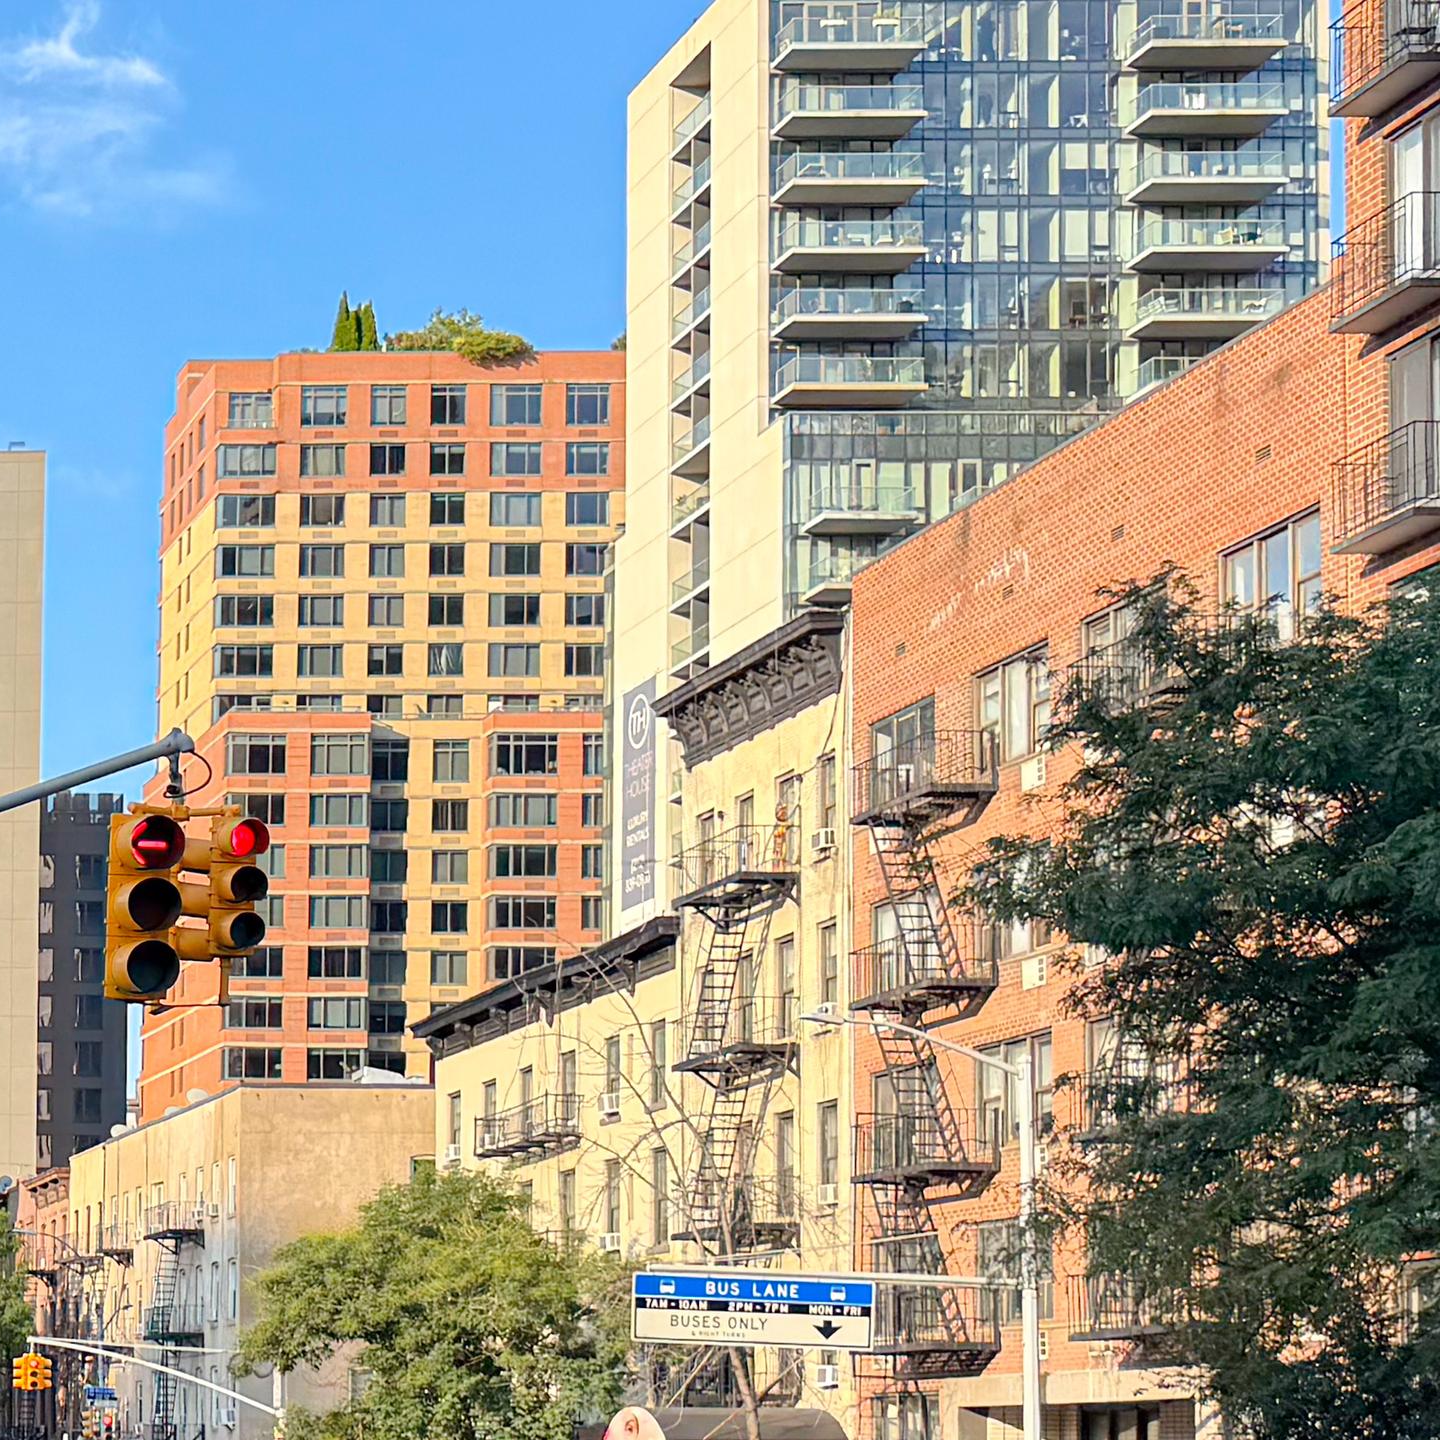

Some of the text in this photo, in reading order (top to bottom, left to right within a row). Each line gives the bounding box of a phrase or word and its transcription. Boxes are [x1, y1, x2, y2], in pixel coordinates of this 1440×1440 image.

[626, 775, 650, 799] HOUSE
[705, 1281, 800, 1299] BUS LANE
[645, 1297, 668, 1309] 7AM
[678, 1299, 708, 1311] 10AM
[727, 1301, 752, 1312] 2PM
[764, 1302, 789, 1314] 7PM
[808, 1304, 834, 1315] MON
[843, 1305, 862, 1316] FRI
[669, 1314, 768, 1331] BUSES ONLY
